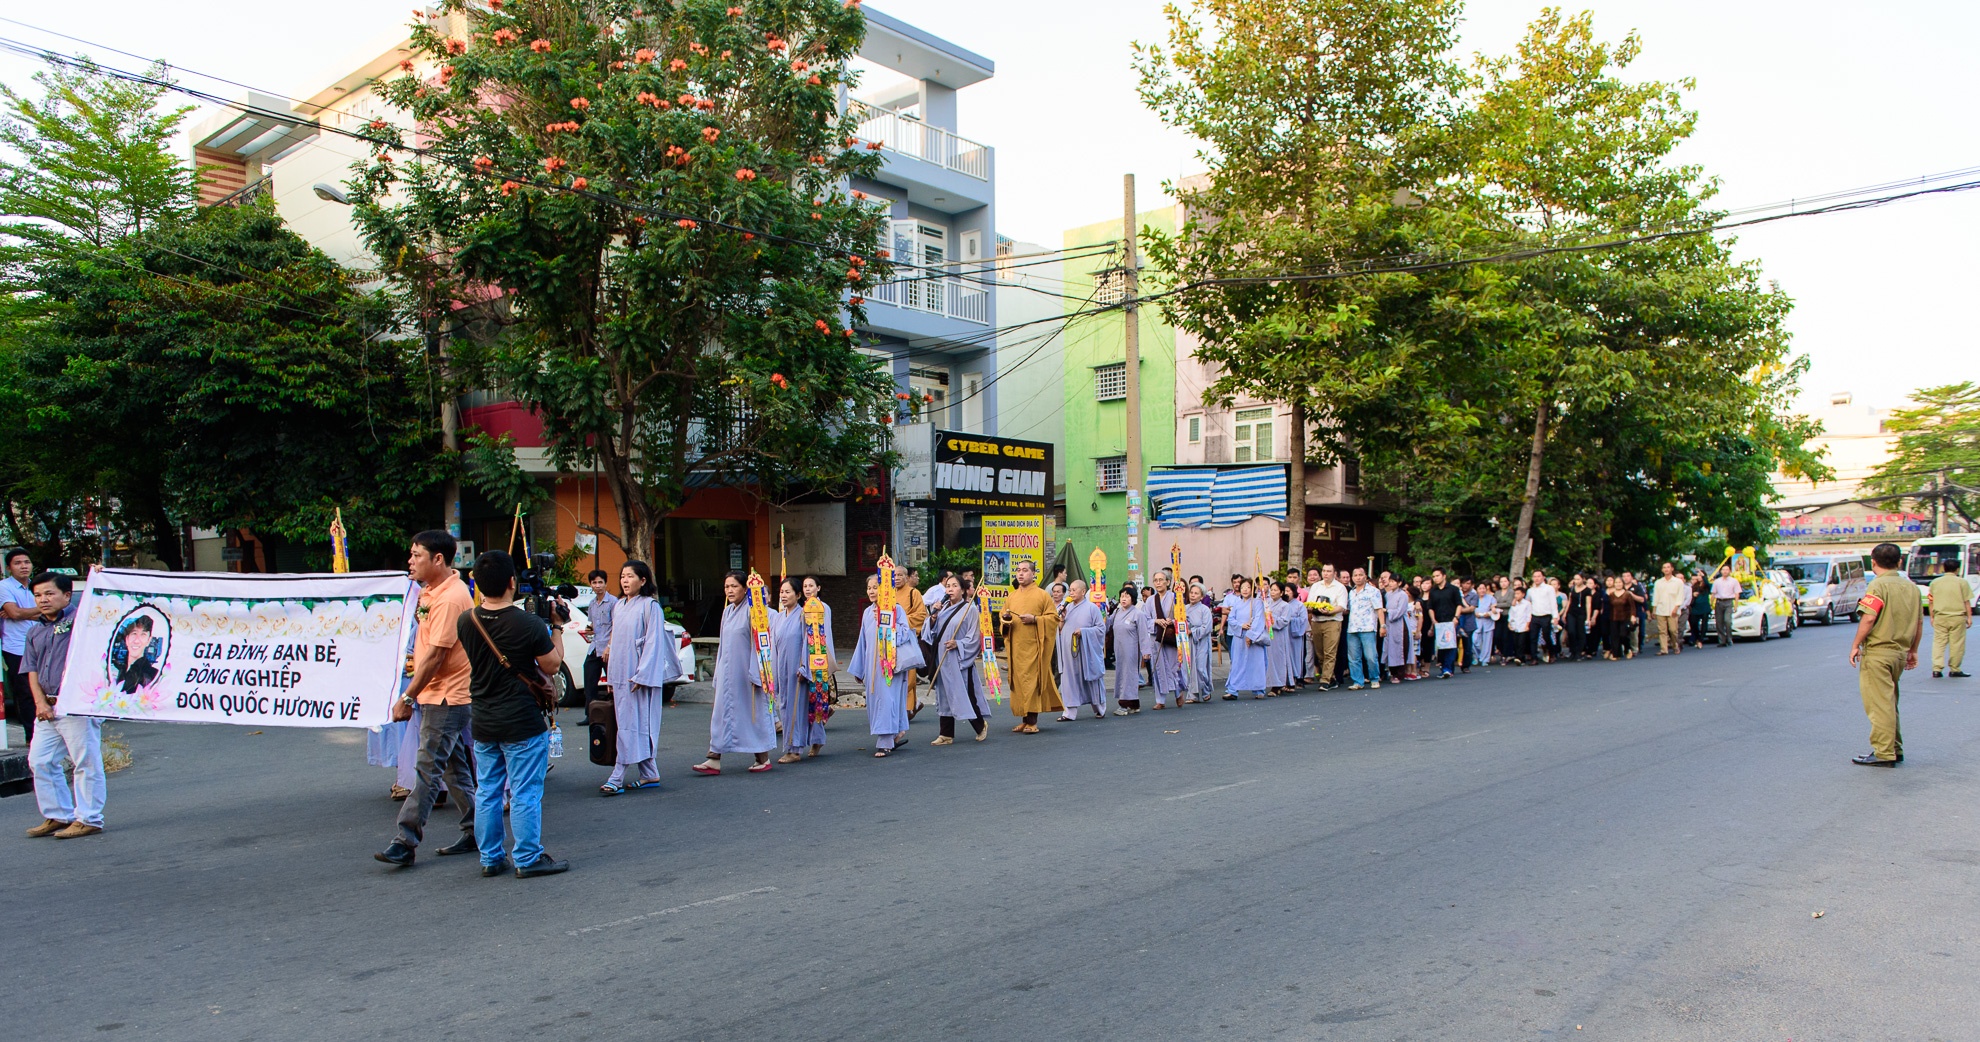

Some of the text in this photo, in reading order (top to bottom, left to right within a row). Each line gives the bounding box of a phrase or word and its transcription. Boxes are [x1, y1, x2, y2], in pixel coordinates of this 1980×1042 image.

[947, 439, 1045, 460] CYBER GAME
[998, 469, 1046, 496] GIAN
[998, 519, 1006, 527] TÂM
[1016, 520, 1025, 528] DỊCH
[1822, 515, 1856, 524] BA
[985, 529, 1039, 552] HẢI PHƯỢNG
[193, 639, 341, 667] GIA ĐÌNH, BẠN BÈ,
[184, 663, 302, 692] ĐỒNG NGHIỆP
[176, 687, 361, 720] ĐÓN QUỐC HƯƠNG VỀ
